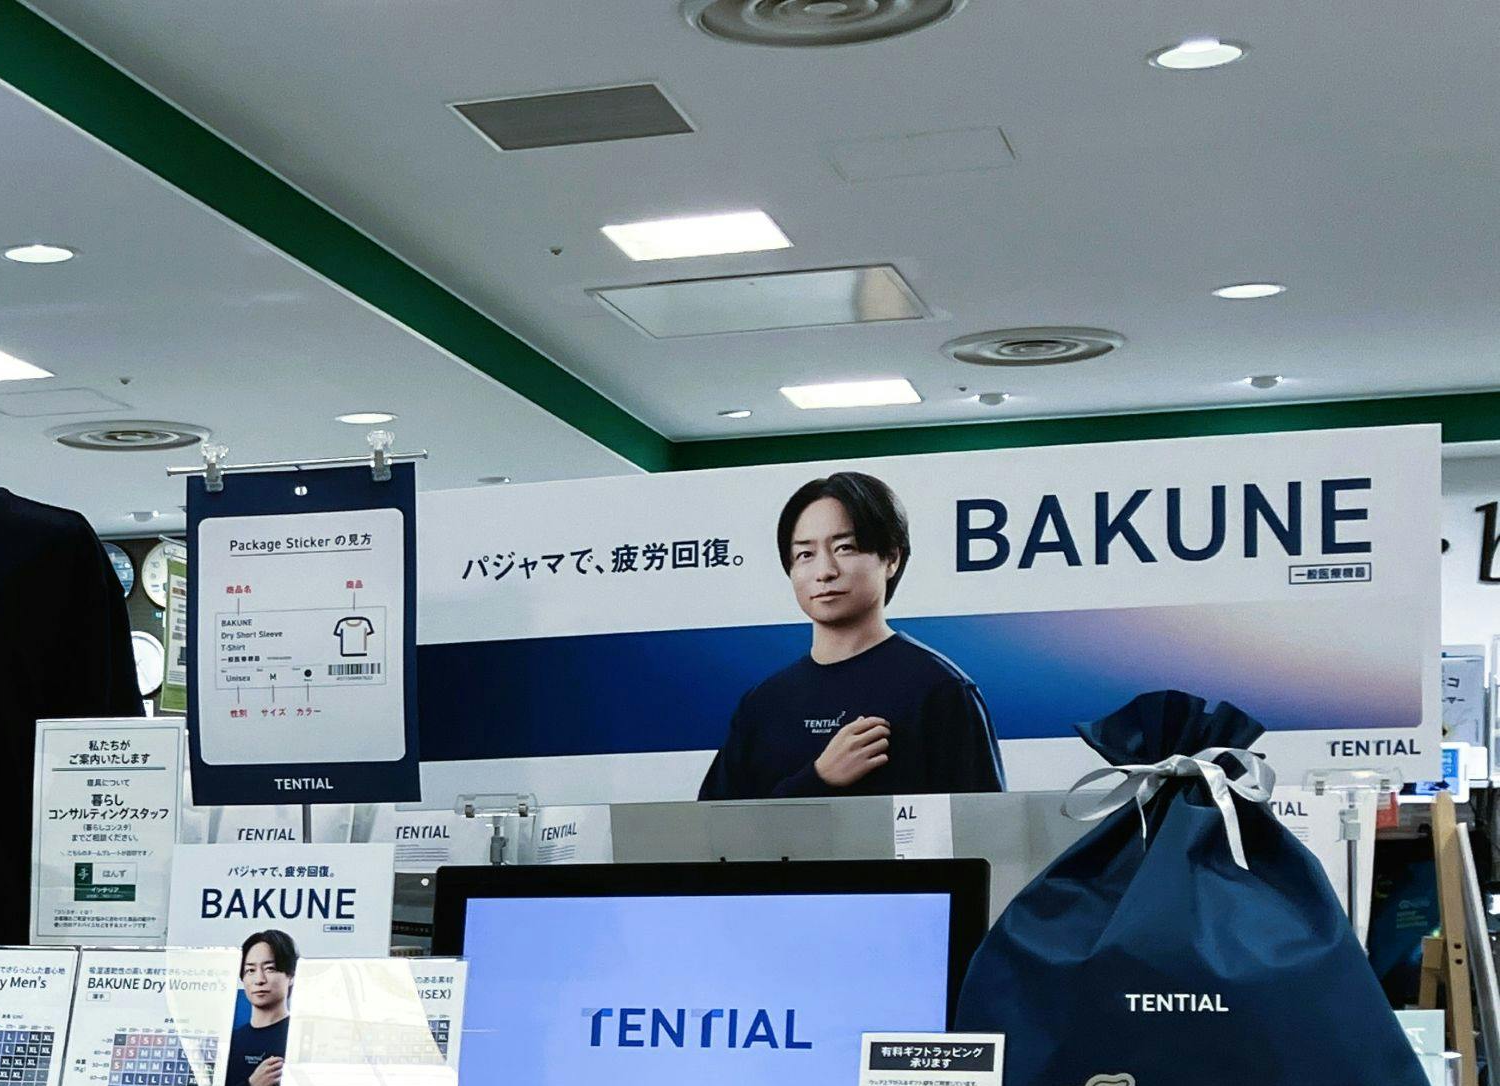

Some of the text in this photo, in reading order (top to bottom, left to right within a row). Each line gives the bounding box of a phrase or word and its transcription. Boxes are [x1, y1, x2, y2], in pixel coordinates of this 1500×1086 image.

[955, 477, 1372, 573] BAKUNE
[230, 533, 372, 552] Package Sticker の見方
[462, 537, 745, 582] パジャマで、疲労回復。
[221, 619, 252, 627] BAKUNE
[221, 632, 234, 640] Dry
[236, 631, 257, 639] Short
[88, 740, 130, 751] 私たちが
[1327, 737, 1422, 758] TENTIAL
[69, 752, 151, 765] ご案内いたします
[274, 777, 334, 791] TENTIAL
[91, 794, 124, 807] 暮らし
[49, 808, 169, 820] コンサルティングスタッフ
[237, 828, 296, 841] TENTIAL
[395, 825, 450, 840] TENTIAL
[541, 822, 577, 842] TENTIAL
[227, 864, 335, 879] パジャマで、疲労回復。
[201, 888, 357, 919] BAKUNE
[9, 976, 47, 989] Men's
[87, 977, 141, 990] BAKUNE
[142, 978, 167, 993] Dry
[1125, 993, 1230, 1013] TENTIAL
[581, 1007, 813, 1049] TENTIAL
[881, 1046, 984, 1058] 有料ギフトラッピング
[909, 1058, 952, 1068] 承ります
